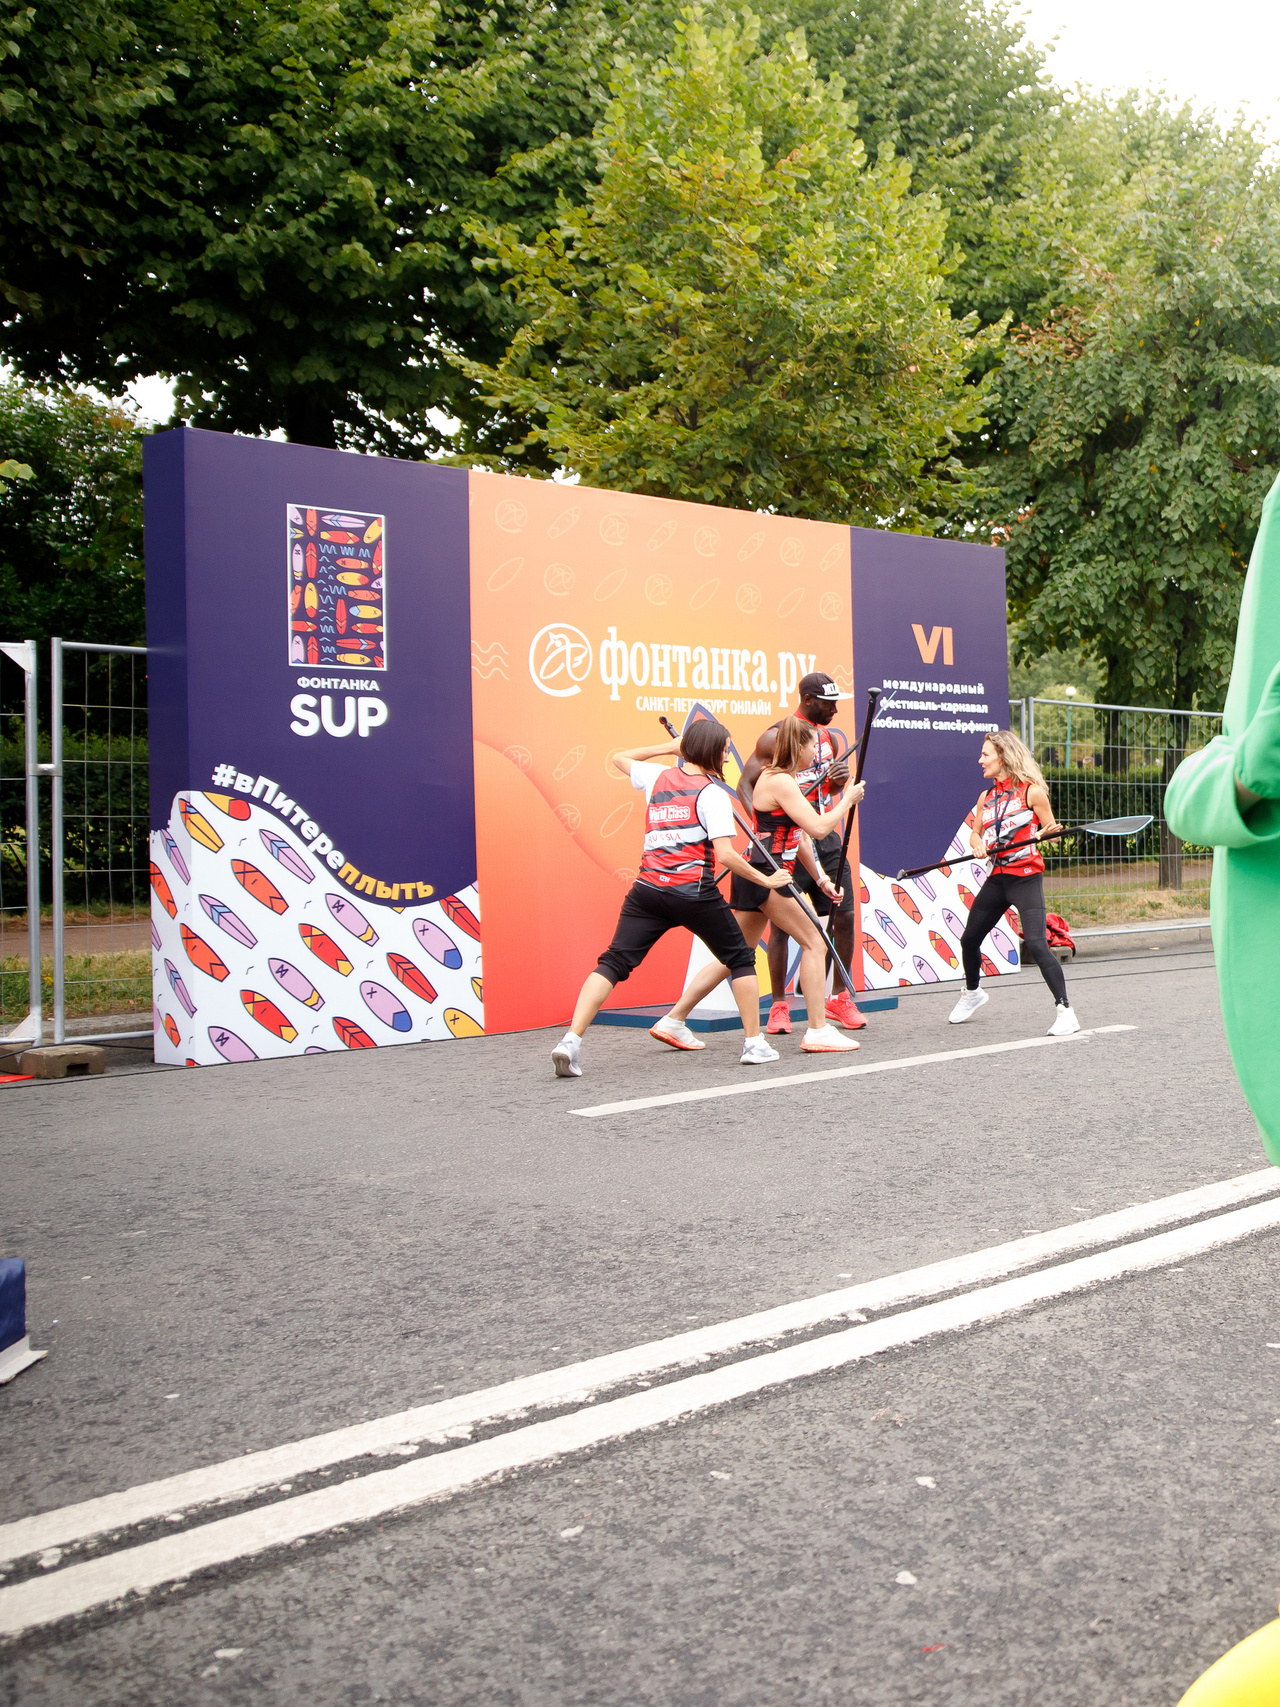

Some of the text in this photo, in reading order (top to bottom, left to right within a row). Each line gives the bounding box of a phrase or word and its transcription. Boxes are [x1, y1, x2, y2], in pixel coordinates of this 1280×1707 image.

[911, 623, 954, 666] VI
[296, 676, 380, 691] ФОНТАНКА
[883, 679, 985, 695] международный
[635, 695, 772, 716] САНКТ-ПЕТРБУРГ ОНЛАЙН
[880, 696, 989, 714] фестиваль-карнавал
[289, 693, 389, 738] SUP
[872, 715, 999, 734] любителей сапсёрфинга
[668, 806, 689, 820] Class
